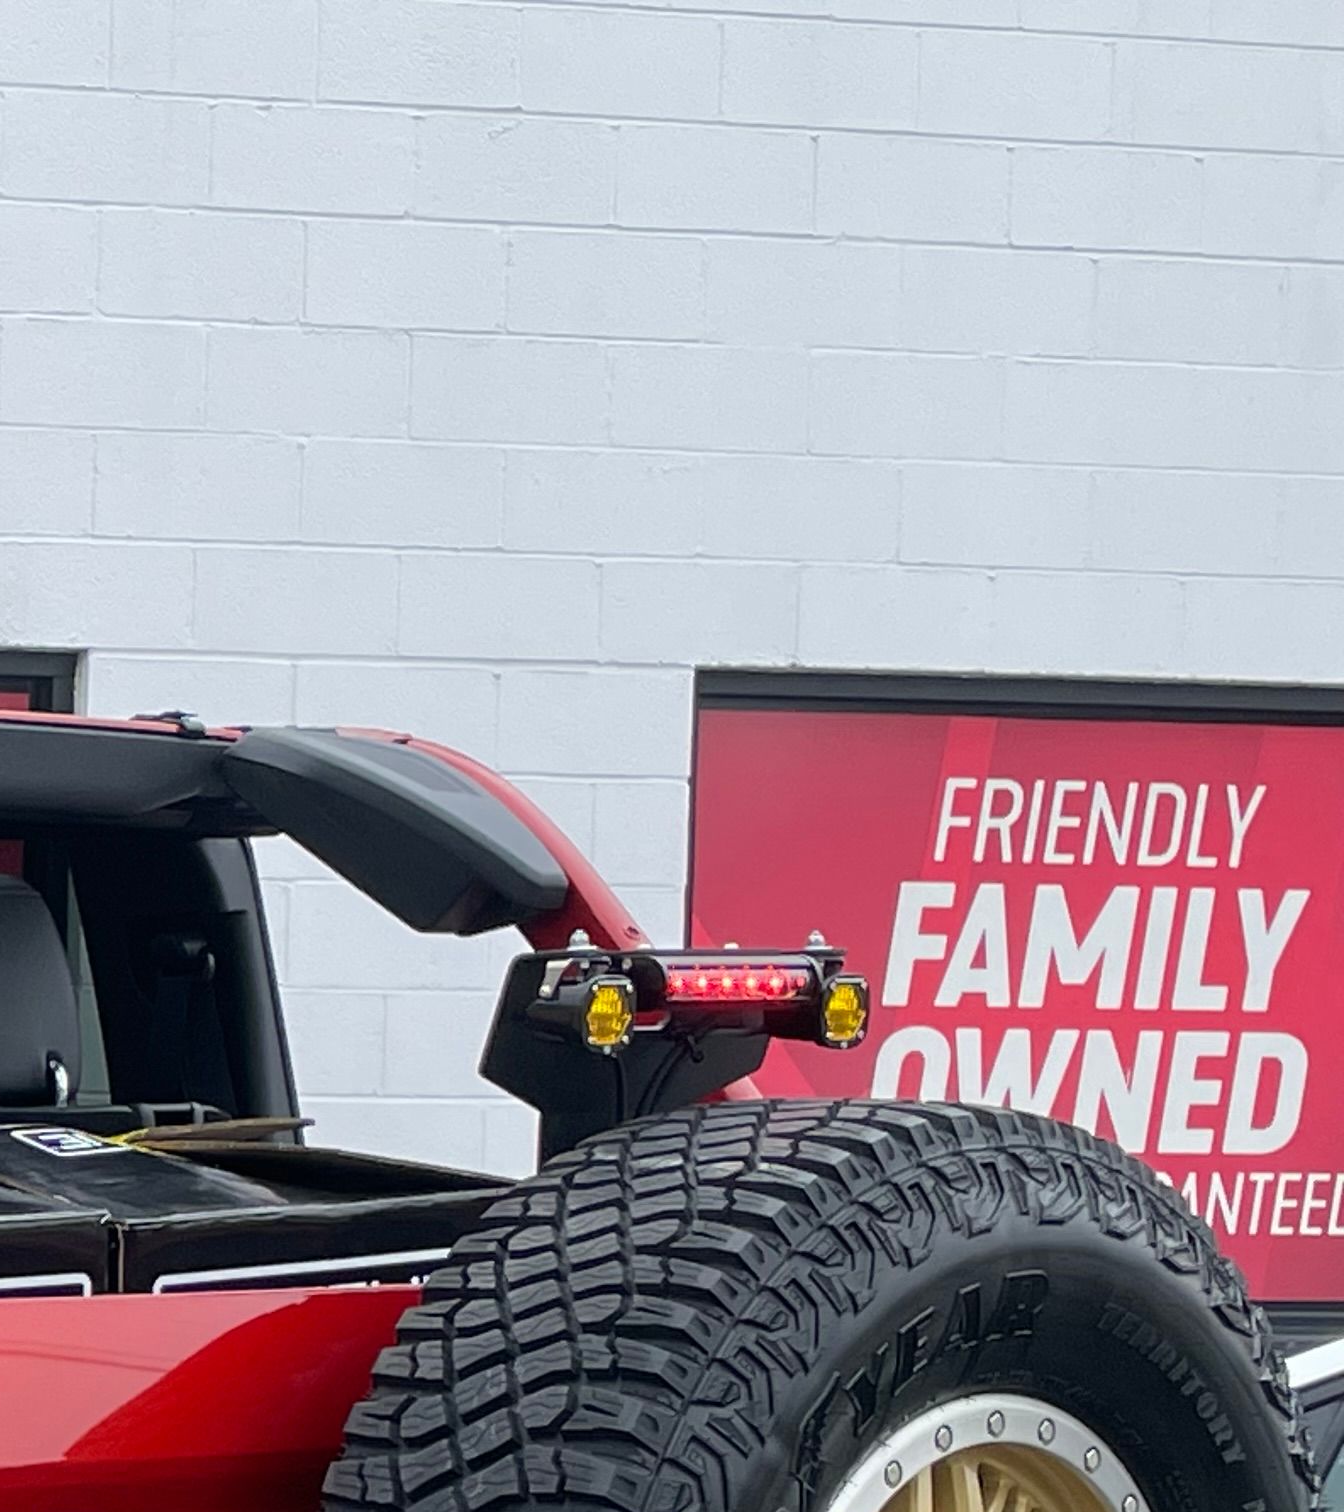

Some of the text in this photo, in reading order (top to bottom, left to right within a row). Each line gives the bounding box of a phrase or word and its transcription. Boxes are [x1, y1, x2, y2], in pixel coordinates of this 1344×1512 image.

[933, 777, 1267, 869] FRIENDLY
[881, 881, 1311, 1012] FAMILY
[870, 1025, 1309, 1155] OWNED
[1097, 1302, 1246, 1465] TERRITORY
